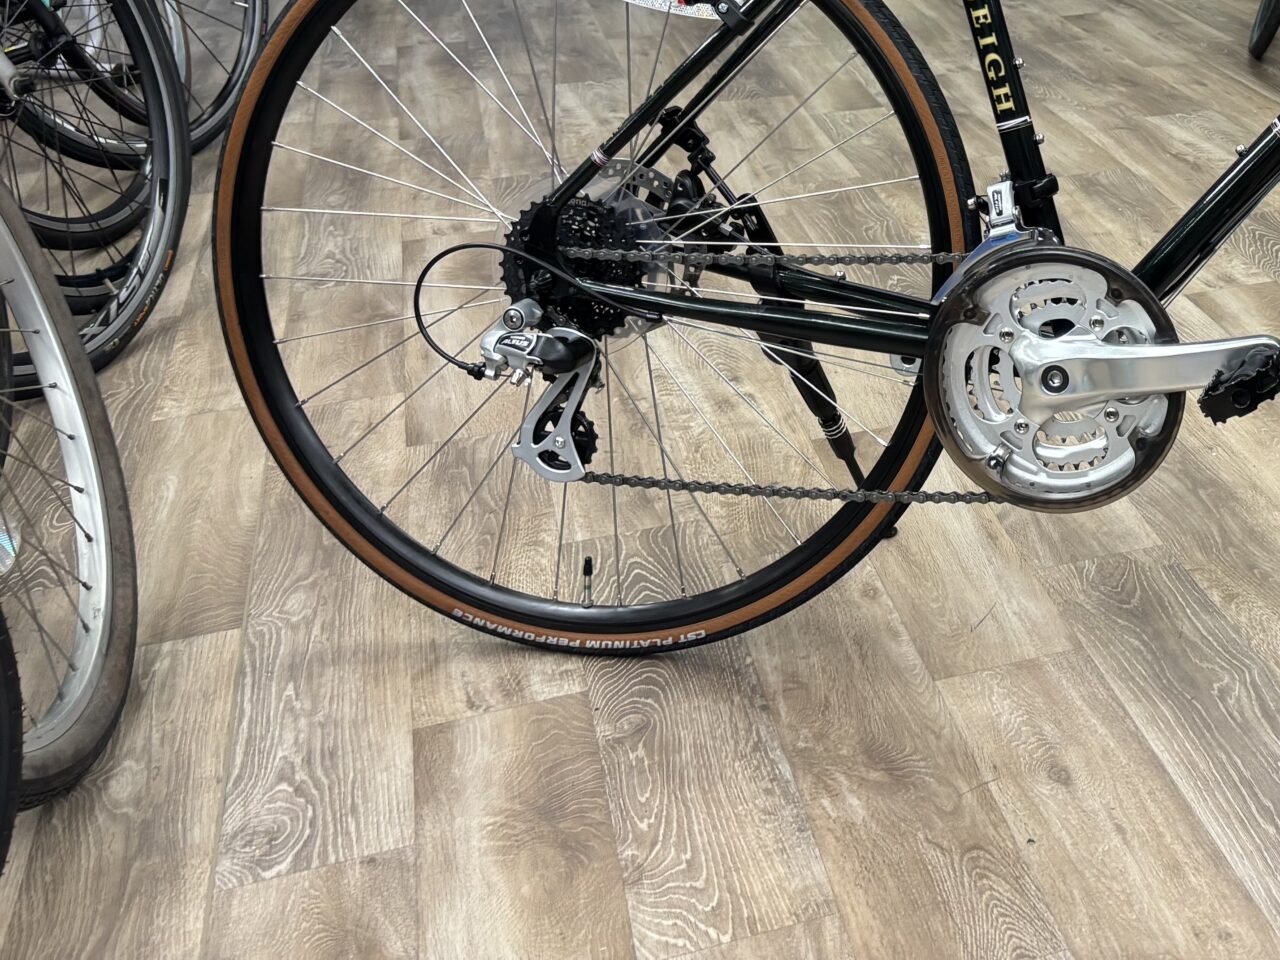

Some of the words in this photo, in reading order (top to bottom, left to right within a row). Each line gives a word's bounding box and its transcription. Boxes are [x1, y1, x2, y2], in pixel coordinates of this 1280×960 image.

[501, 338, 529, 347] ALTUS
[450, 607, 582, 648] PERFORMANCE
[585, 635, 673, 650] PLATINUM
[677, 629, 707, 643] CST
